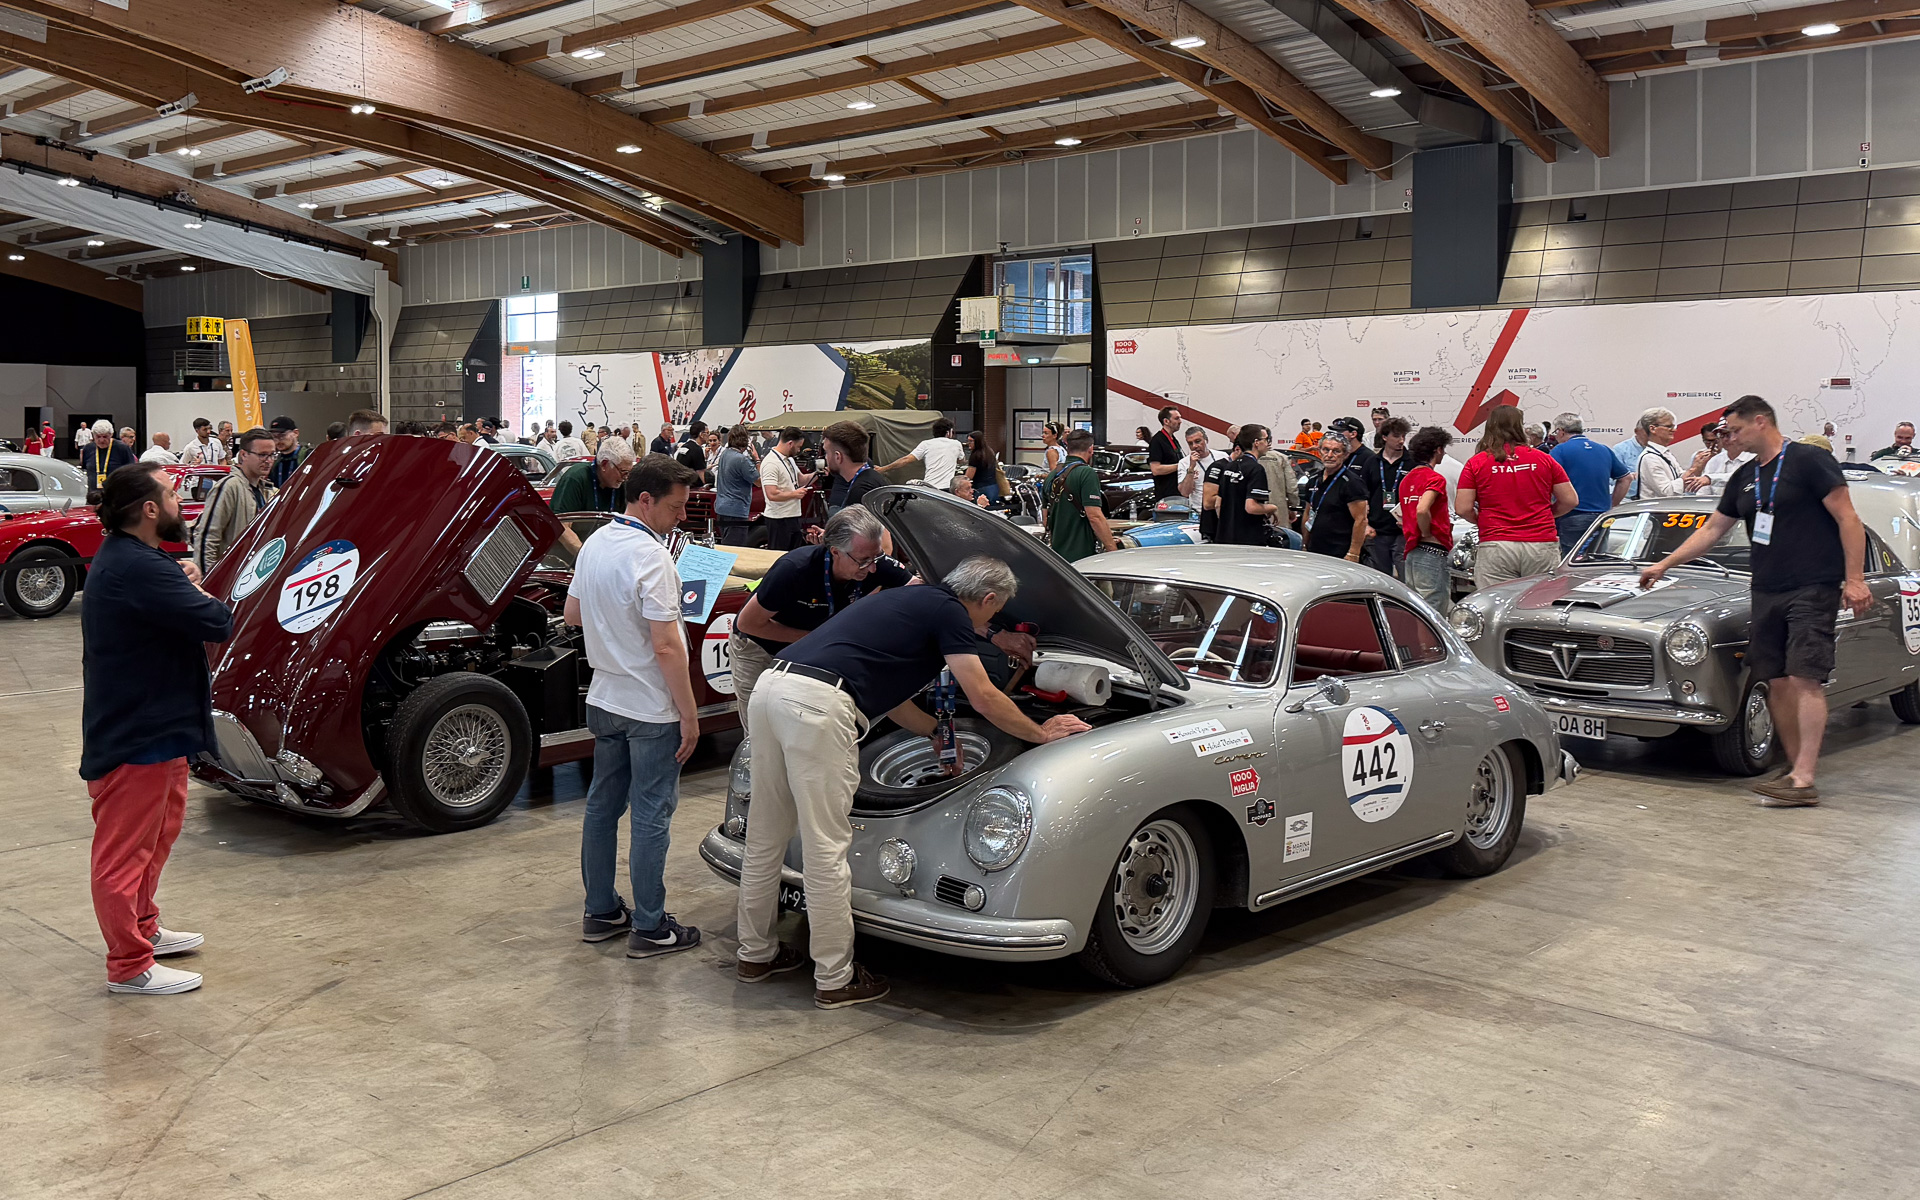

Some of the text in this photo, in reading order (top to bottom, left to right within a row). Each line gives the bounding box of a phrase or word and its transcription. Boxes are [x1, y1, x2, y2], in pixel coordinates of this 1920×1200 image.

[1491, 463, 1538, 474] STAFF
[1662, 513, 1707, 529] 351
[292, 574, 340, 612] 198
[1906, 598, 1920, 622] 35
[1559, 715, 1605, 737] OA 8H
[1352, 741, 1398, 787] 442
[1232, 771, 1253, 783] 1000
[1233, 781, 1256, 794] MIGLIA
